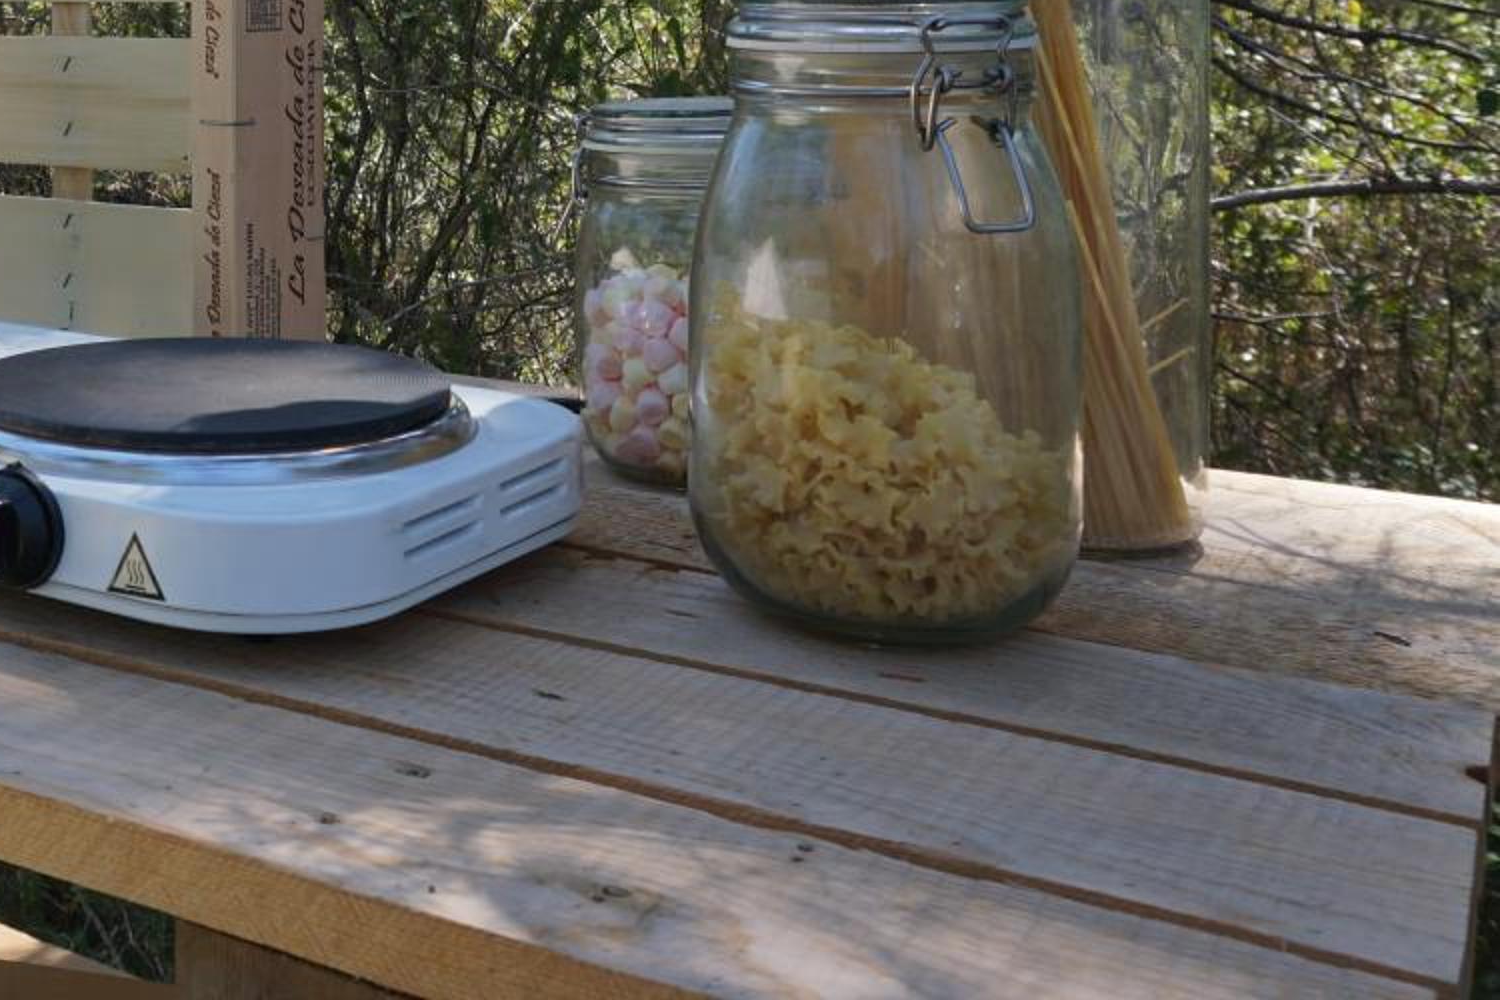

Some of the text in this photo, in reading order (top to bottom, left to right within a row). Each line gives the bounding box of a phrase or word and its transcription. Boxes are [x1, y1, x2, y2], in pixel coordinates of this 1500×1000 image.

[285, 46, 305, 87] de
[285, 96, 306, 243] Deseada
[287, 254, 306, 306] La
